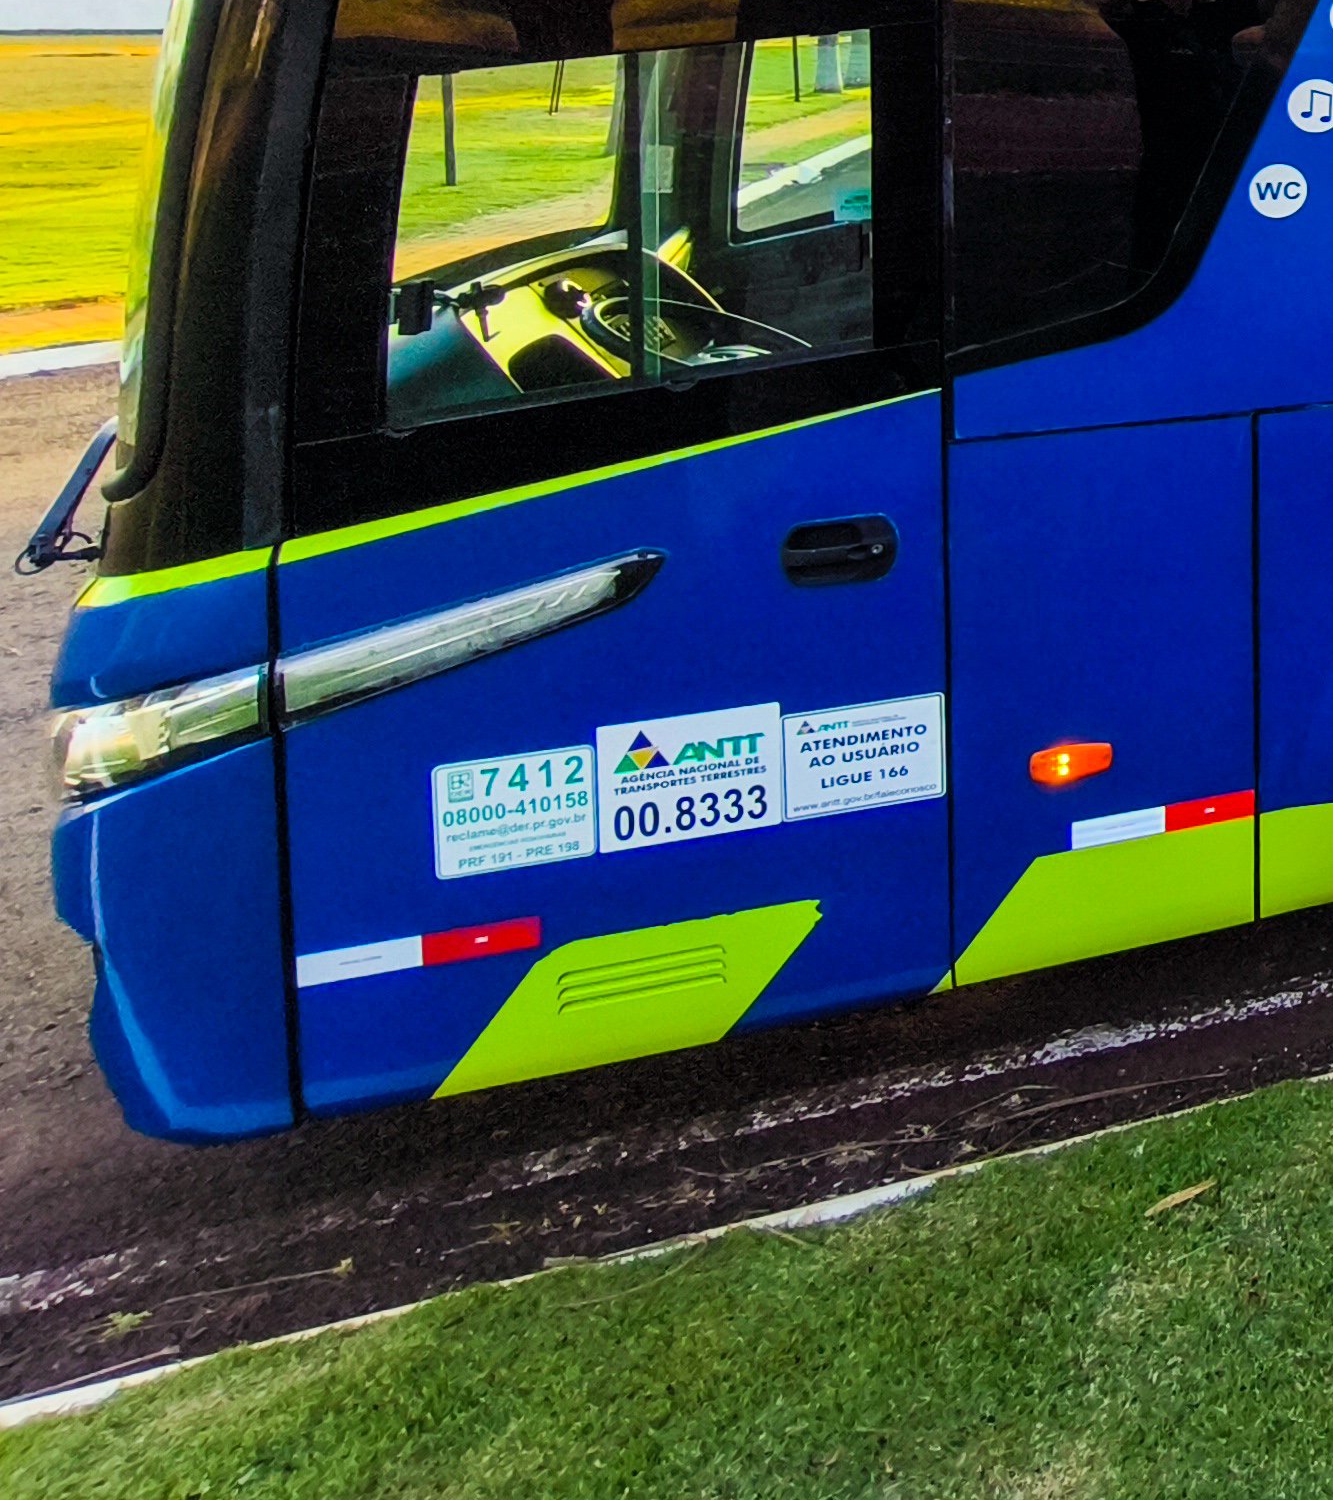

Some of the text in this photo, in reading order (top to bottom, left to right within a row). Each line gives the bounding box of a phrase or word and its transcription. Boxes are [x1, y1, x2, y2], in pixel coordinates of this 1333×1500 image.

[1255, 181, 1302, 201] WC
[673, 732, 765, 766] ANTT
[800, 724, 927, 754] ATENDIMENTO
[679, 759, 741, 775] NACIONAL
[745, 756, 760, 766] DE
[809, 741, 920, 769] AO USUÁRIO
[480, 755, 585, 797] 7412
[614, 765, 767, 796] TRANSPORTES TERRESTRES
[821, 765, 909, 789] LIGUE 166
[442, 790, 589, 827] 08000-410158
[613, 784, 768, 841] 00.8333
